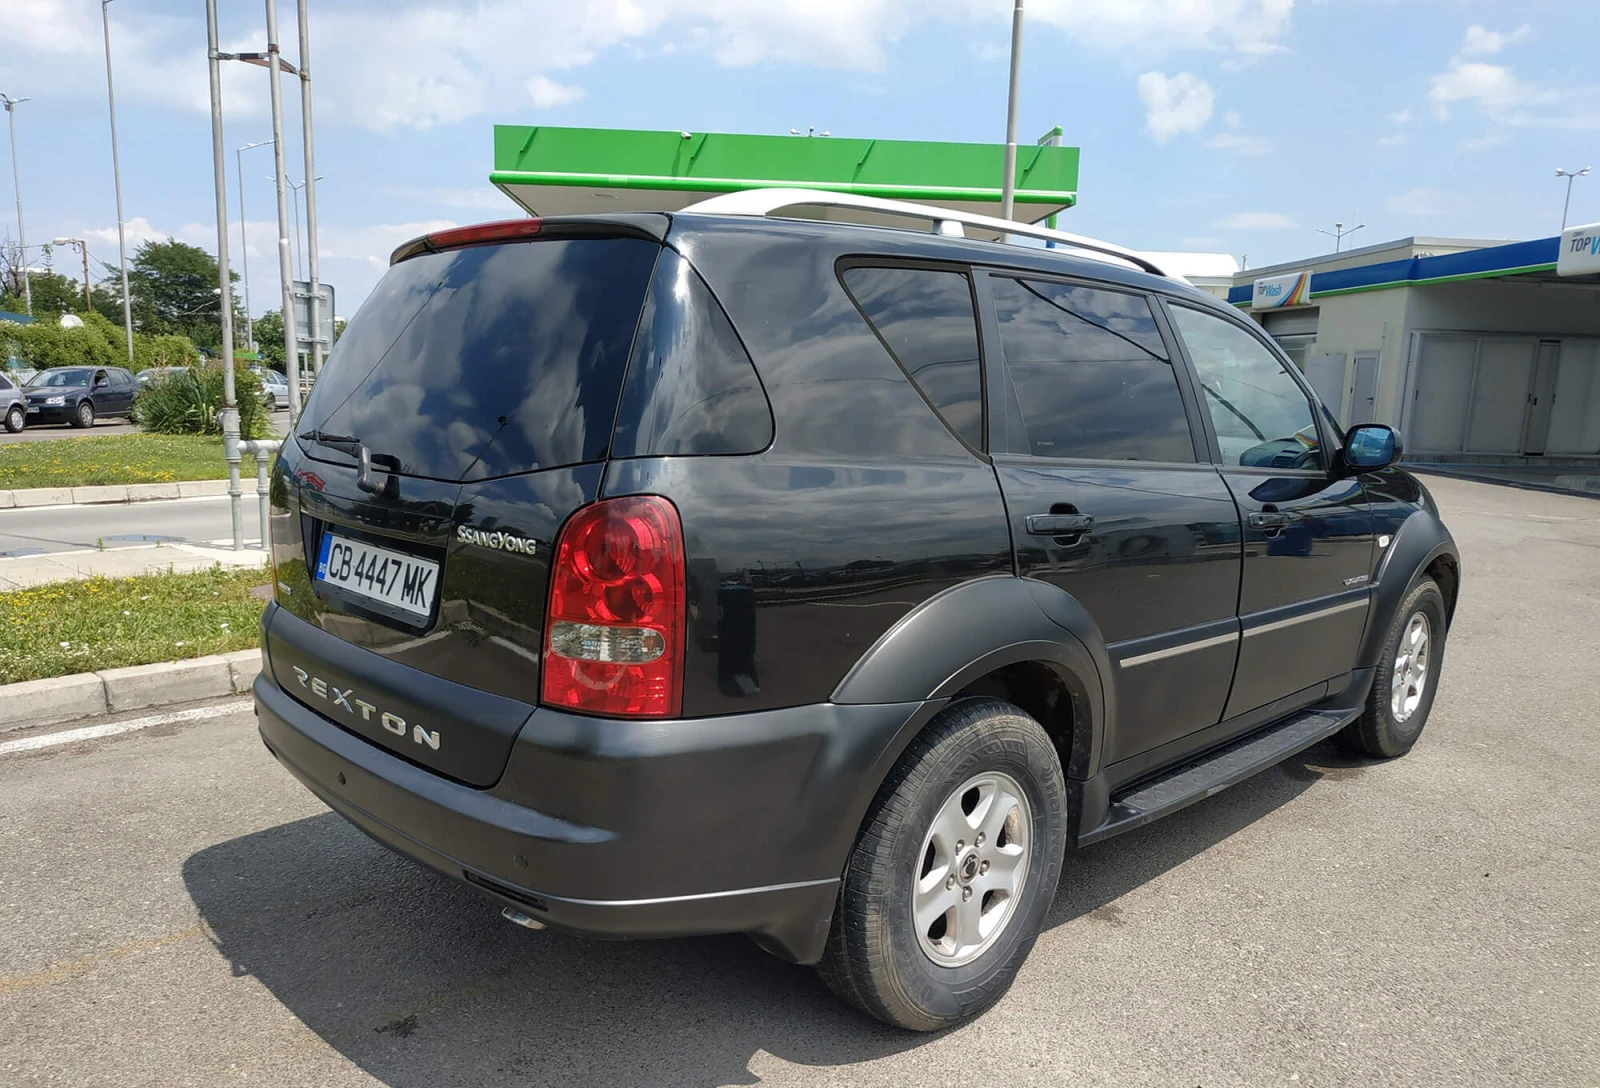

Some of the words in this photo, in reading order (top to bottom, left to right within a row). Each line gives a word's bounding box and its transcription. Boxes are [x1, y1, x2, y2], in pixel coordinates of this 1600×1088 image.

[354, 551, 402, 597] 4447
[400, 562, 433, 609] MK
[292, 665, 440, 751] REXTON
